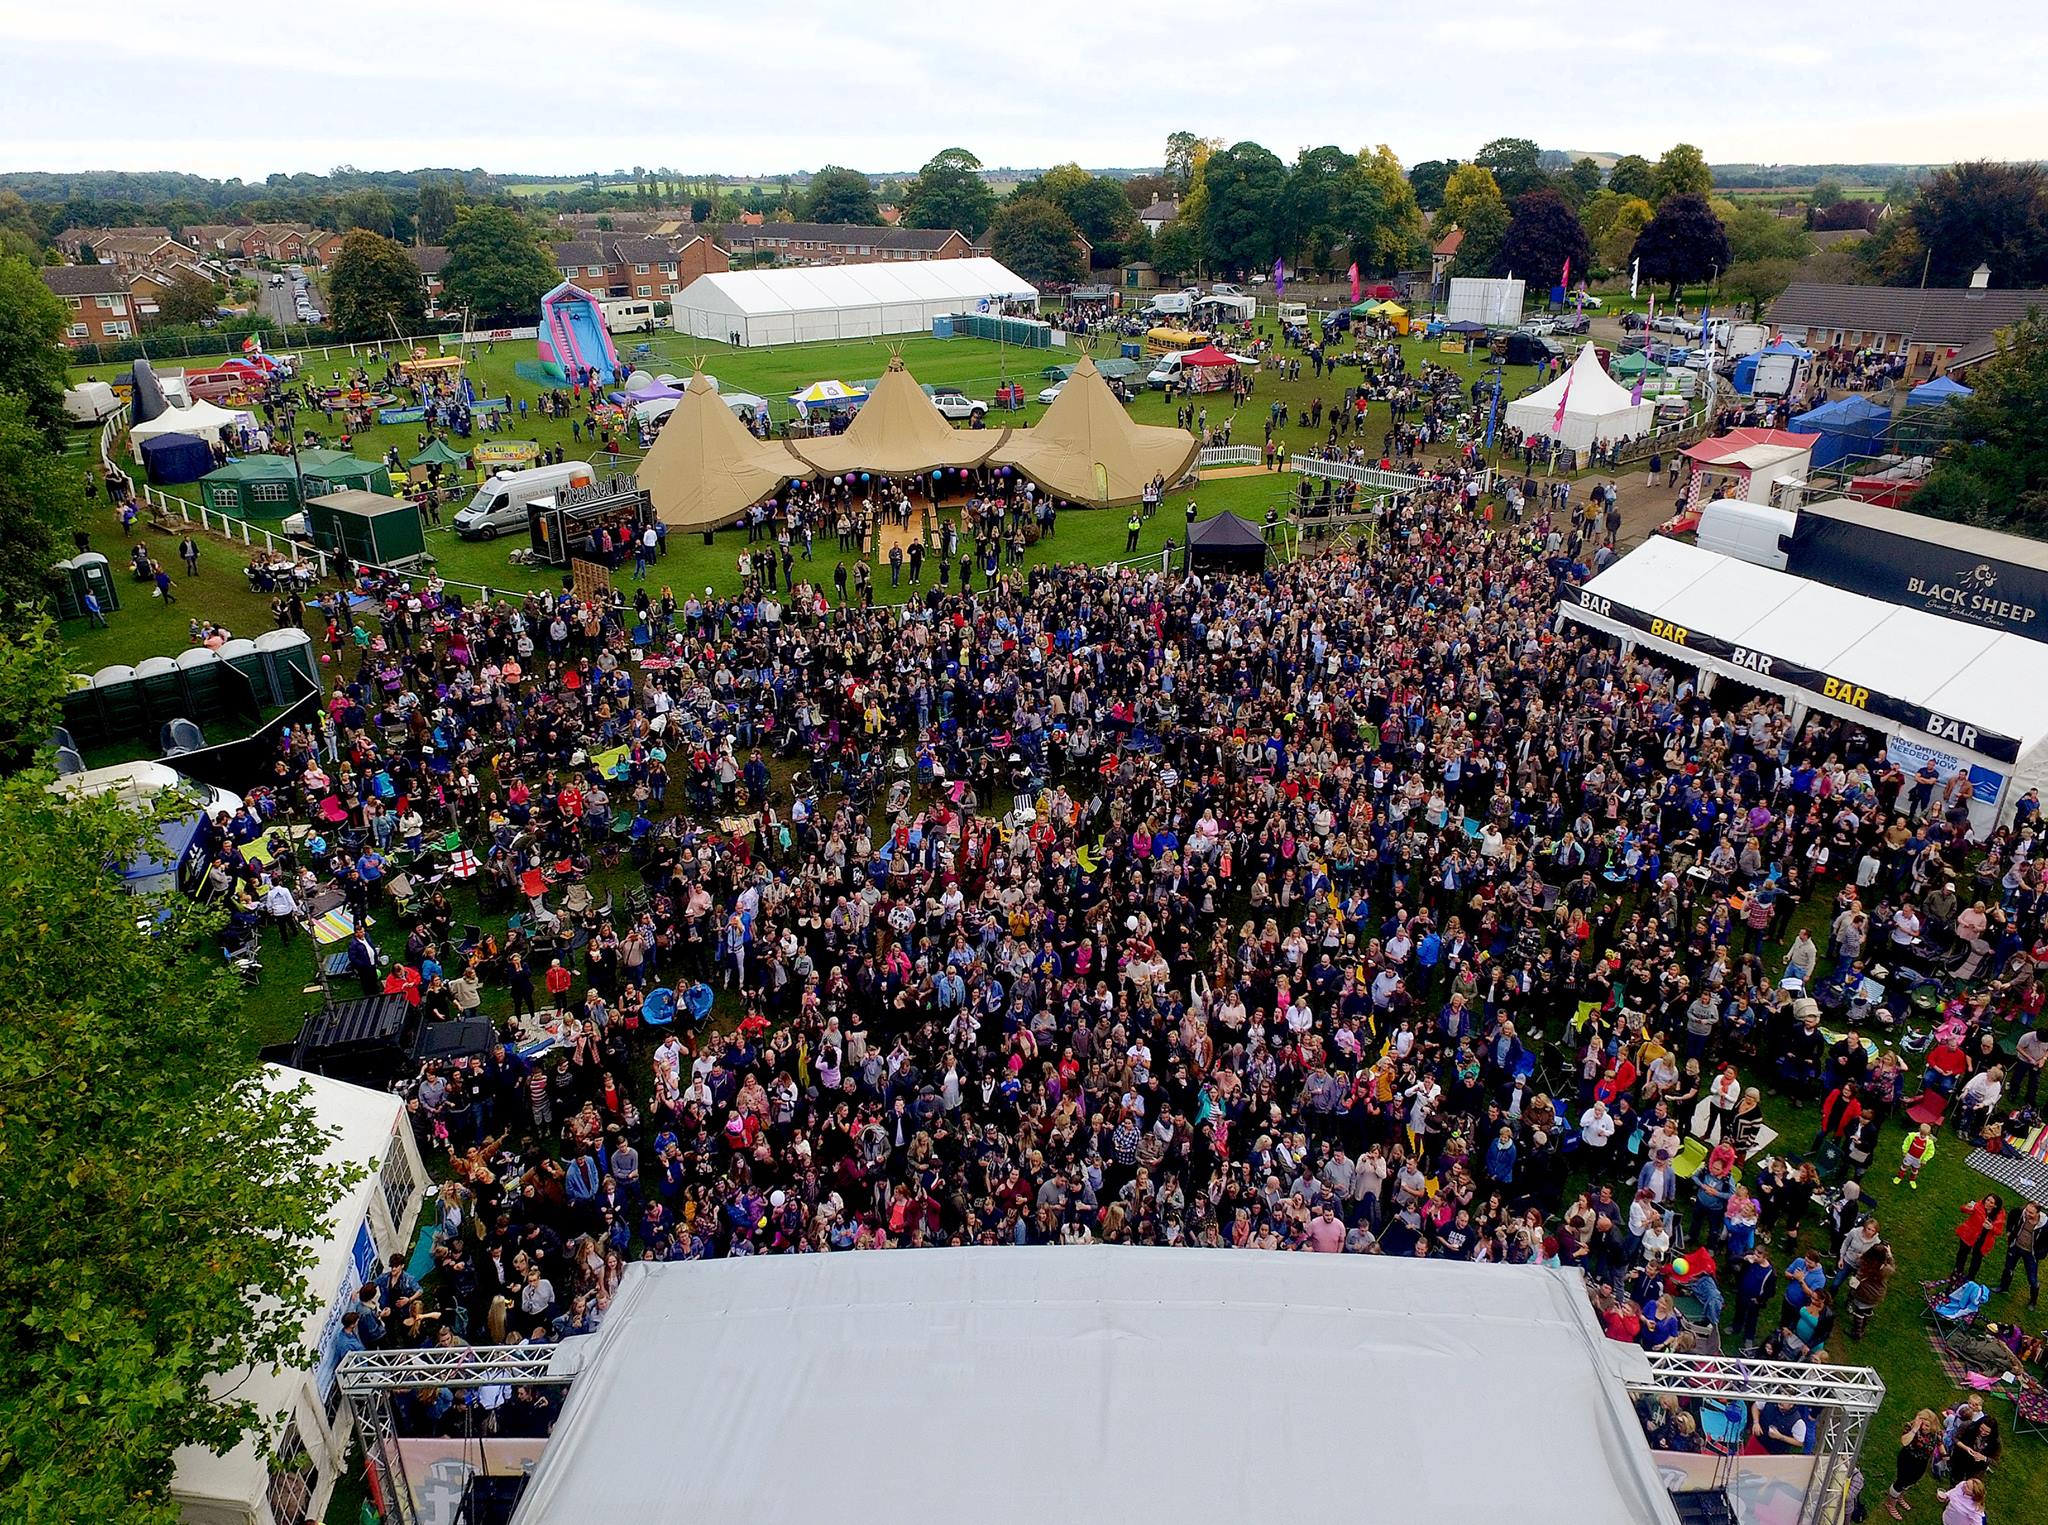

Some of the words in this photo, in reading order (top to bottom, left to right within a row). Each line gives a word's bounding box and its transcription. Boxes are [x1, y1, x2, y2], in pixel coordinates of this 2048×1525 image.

[489, 329, 512, 338] JMS
[556, 474, 614, 507] Licensed
[615, 471, 640, 494] Bar
[1580, 591, 1612, 616] BAR
[1906, 576, 1969, 606] BLACK
[1970, 595, 2036, 623] SHEEP
[1651, 618, 1689, 645] BAR
[1732, 647, 1773, 675] BAR
[1823, 677, 1869, 709] BAR
[1926, 713, 1978, 748] BAR
[1889, 743, 1930, 761] NEEDED
[1931, 757, 1958, 771] NOW
[1891, 735, 1914, 749] HGV
[1914, 744, 1959, 764] DRIVERS
